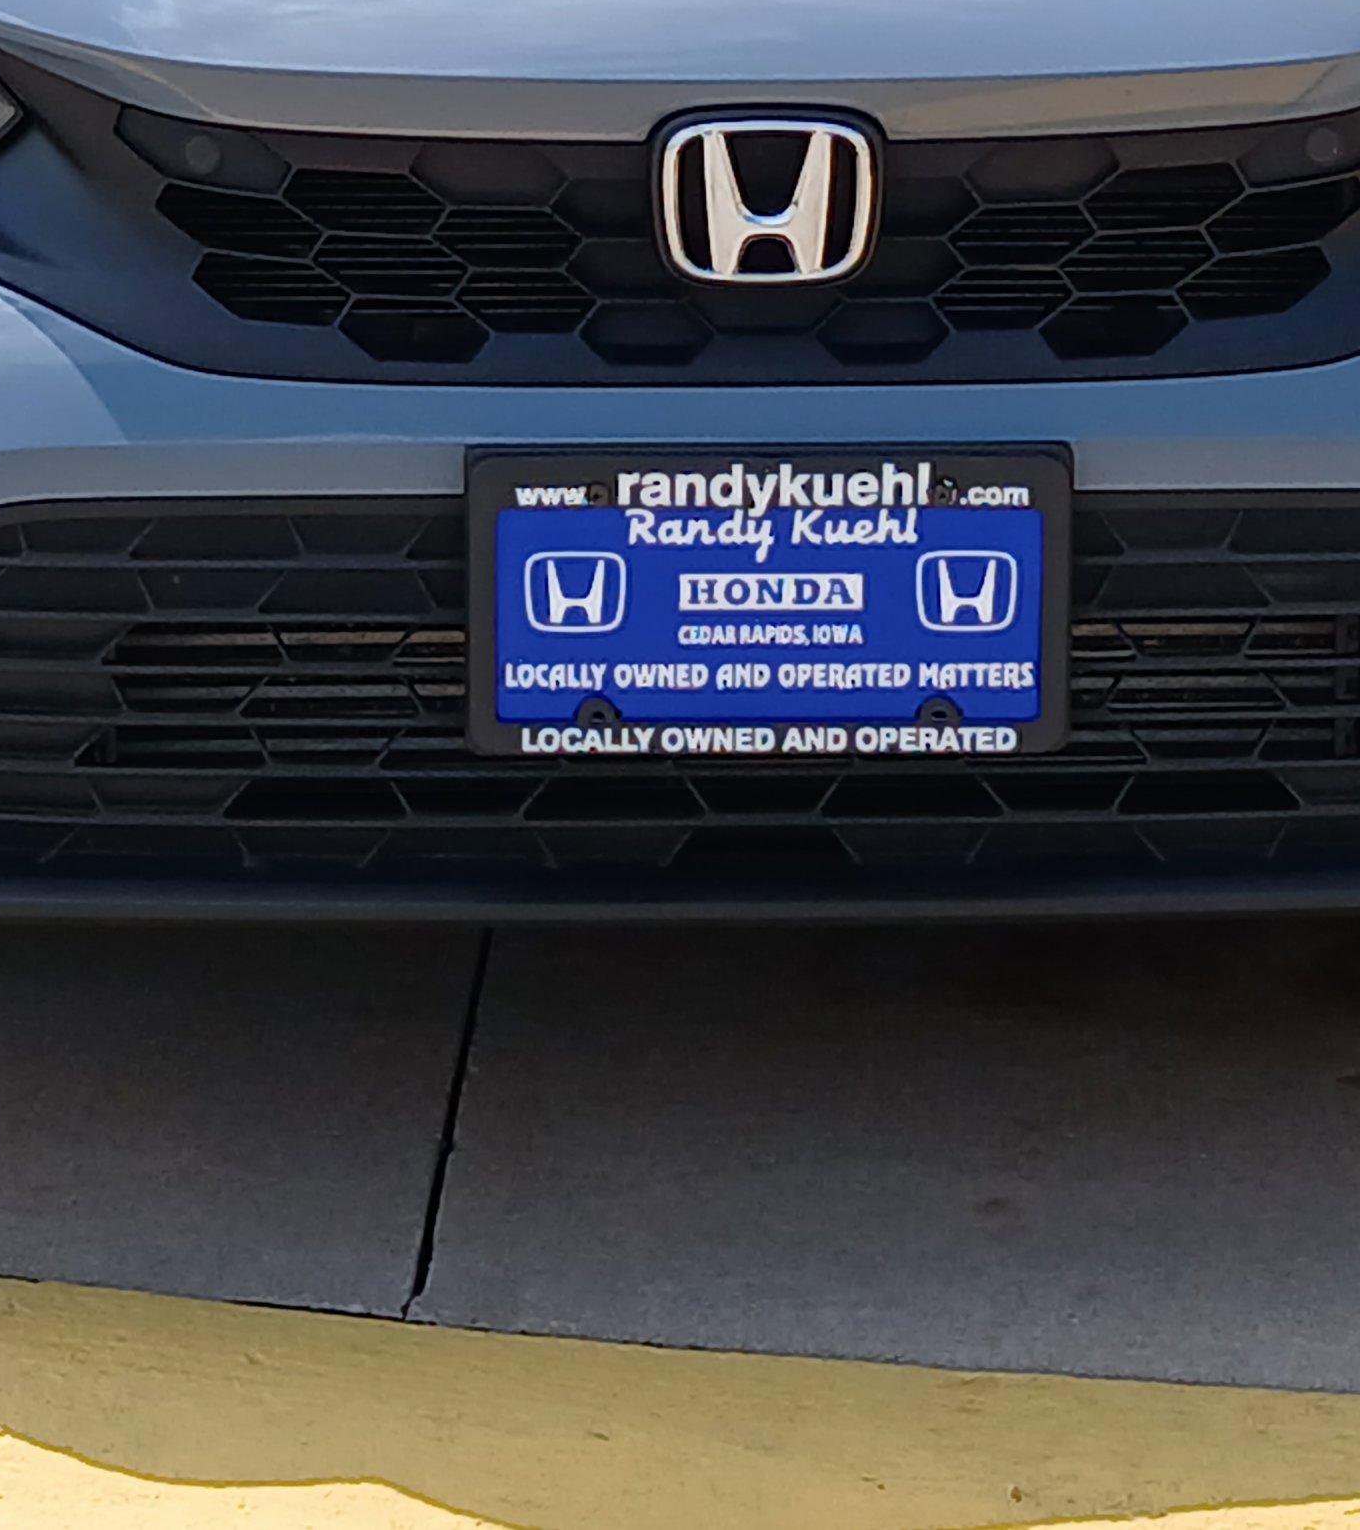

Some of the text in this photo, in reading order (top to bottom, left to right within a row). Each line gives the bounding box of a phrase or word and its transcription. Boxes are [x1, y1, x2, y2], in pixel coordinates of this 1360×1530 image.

[617, 462, 931, 517] randykuehl
[625, 507, 919, 563] Randy Kuehl
[687, 578, 855, 606] HONDA
[678, 625, 864, 646] CEDAR RAPIDS, IOWA
[505, 662, 1036, 691] LOCALLY OWNED AND OPERATED MATTERS
[521, 727, 1018, 753] LOCALLY OWNED AND OPERATED
